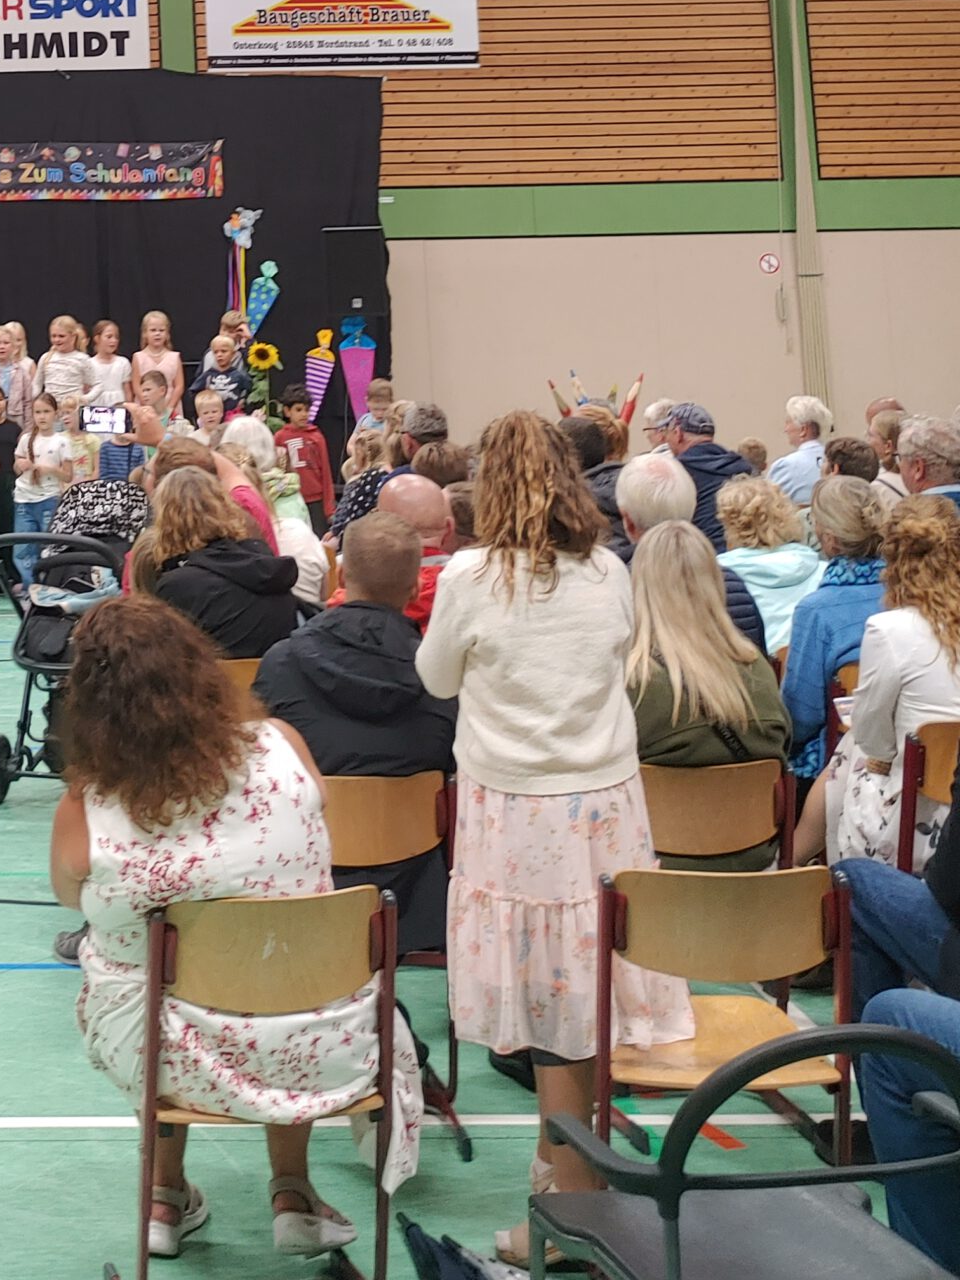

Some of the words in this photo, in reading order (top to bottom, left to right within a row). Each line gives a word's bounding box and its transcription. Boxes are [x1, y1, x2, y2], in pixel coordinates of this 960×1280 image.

[257, 6, 363, 28] Baugeschäft
[369, 7, 430, 23] Brauer
[317, 39, 370, 49] Nordstrand
[19, 162, 64, 184] Zum
[69, 161, 206, 187] Schulanfang
